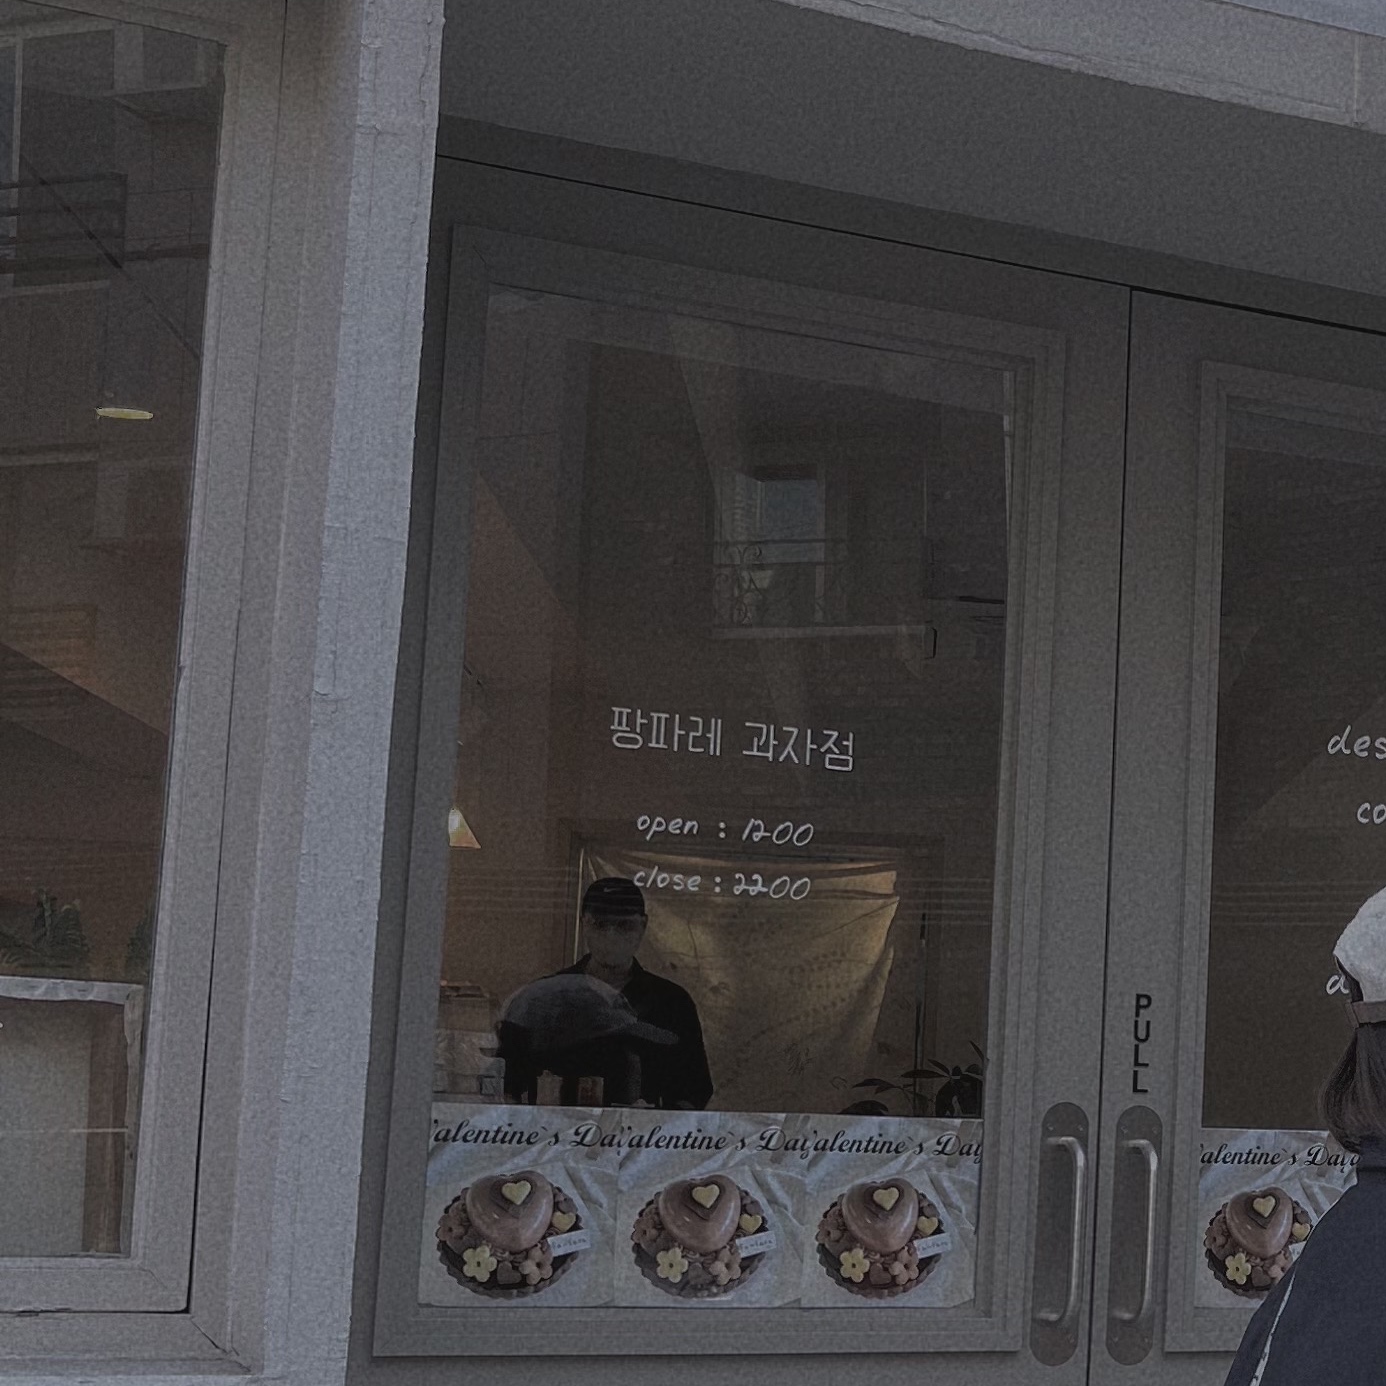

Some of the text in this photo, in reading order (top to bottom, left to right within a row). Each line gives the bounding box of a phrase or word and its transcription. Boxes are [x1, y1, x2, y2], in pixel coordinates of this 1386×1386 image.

[610, 706, 854, 772] 팡파레 과자점
[636, 815, 699, 841] open
[741, 818, 814, 847] 1200
[633, 865, 702, 892] close
[732, 872, 812, 900] 2200
[1131, 992, 1153, 1094] PULL
